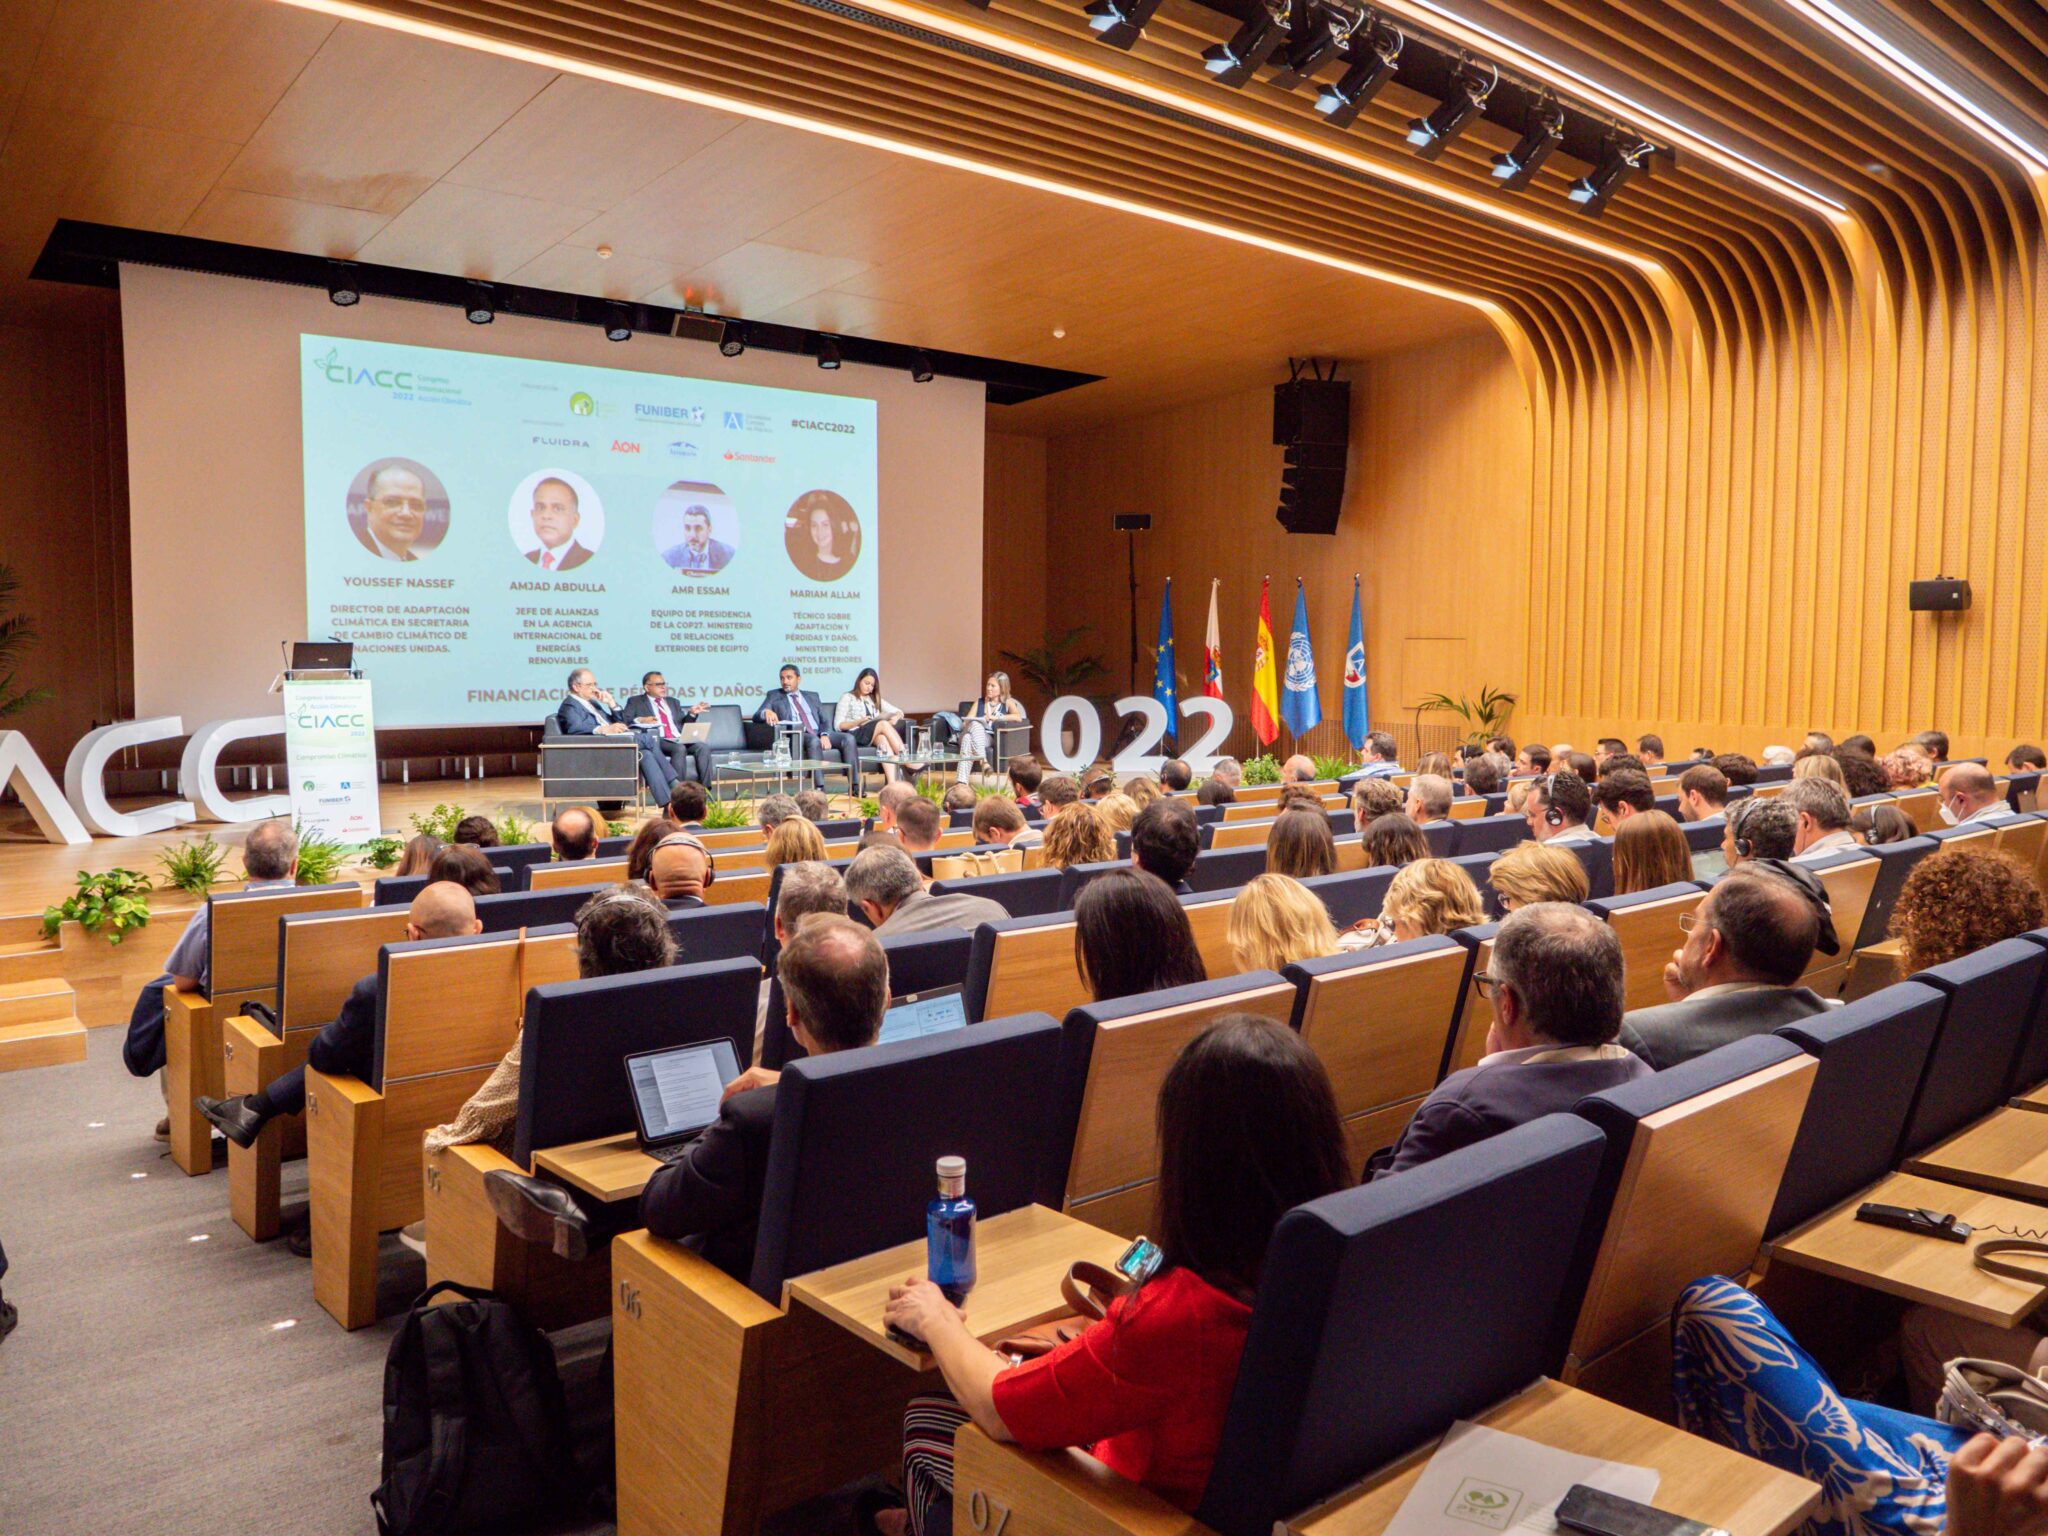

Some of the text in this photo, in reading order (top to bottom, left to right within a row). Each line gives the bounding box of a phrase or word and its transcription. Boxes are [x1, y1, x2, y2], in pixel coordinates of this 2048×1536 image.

[325, 365, 413, 390] CIACC
[392, 392, 414, 401] 2022
[635, 403, 689, 419] FUNIBER
[791, 419, 856, 434] #CIACC2022
[532, 436, 776, 464] FLUIDRA AON Santander
[343, 576, 455, 589] YOUSSEF NASSEF
[510, 581, 606, 592] AMJAD ABDULLA
[671, 585, 730, 596] AMR ESSAM
[790, 589, 861, 599] MARIAM ALLAM
[330, 604, 470, 615] DIRECTOR DE ADAPTACIÓN
[515, 607, 600, 616] JEFE DE ALIANZAS
[651, 609, 752, 619] EQUIPO DE PRESIDENCIA
[331, 616, 389, 627] CLIMÁTICA
[391, 618, 405, 627] EN
[827, 612, 851, 621] SOBRE
[523, 620, 593, 628] EN LA AGENCIA
[650, 621, 662, 629] DE
[663, 621, 675, 629] LA
[707, 622, 753, 630] MINISTERIO
[334, 629, 468, 640] DE CAMBIO CLIMÁTICO DE
[513, 632, 602, 641] INTERNACIONAL DE
[670, 633, 734, 641] DE RELACIONES
[354, 644, 450, 653] NACIONES UNIDAS.
[655, 645, 749, 653] EXTERIORES DE EGIPTO
[795, 645, 838, 653] MINISTERIO
[528, 657, 589, 665] RENOVABLES
[802, 667, 813, 675] DE
[467, 687, 571, 703] FINANCIACI
[619, 683, 696, 700] PÉDAS
[699, 686, 709, 698] Y
[298, 714, 365, 729] CIACC
[1010, 695, 1234, 773] 022
[619, 1279, 642, 1320] 06
[968, 1487, 1011, 1536] 07
